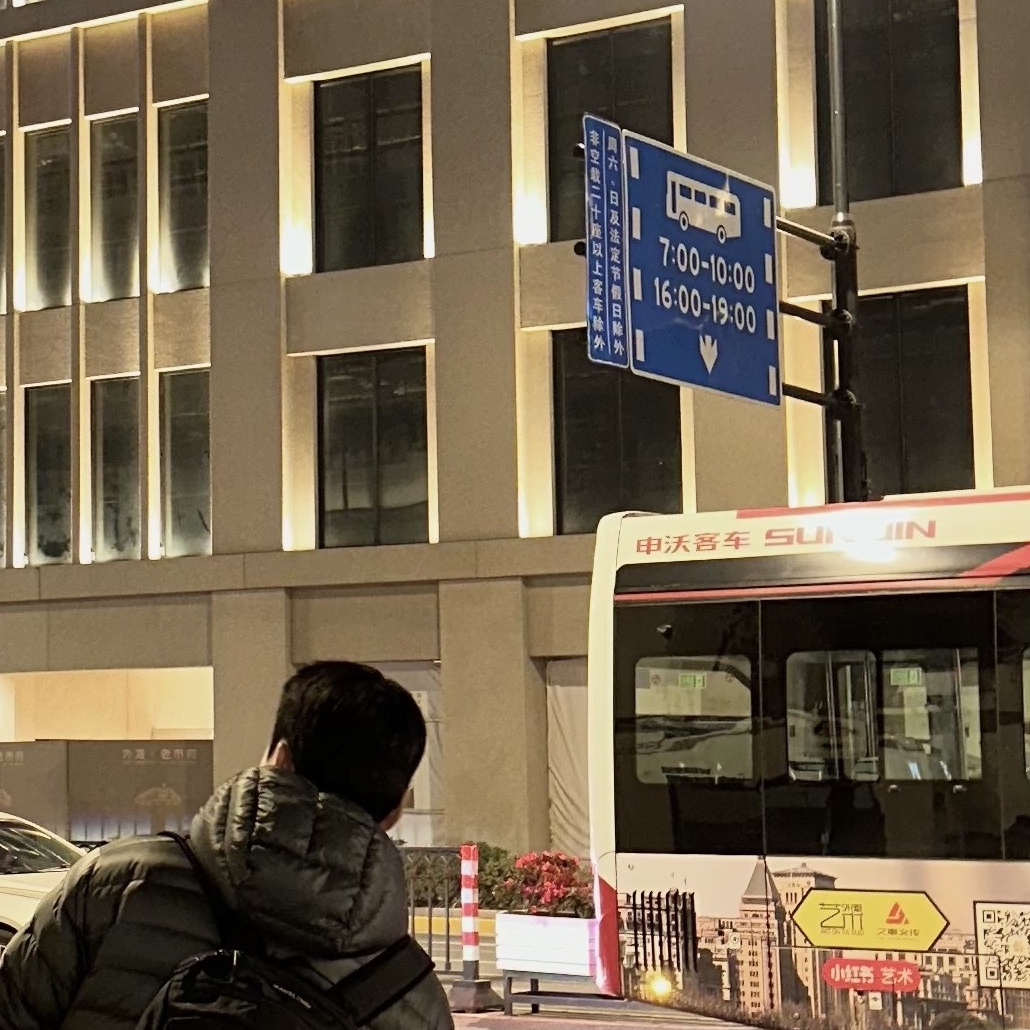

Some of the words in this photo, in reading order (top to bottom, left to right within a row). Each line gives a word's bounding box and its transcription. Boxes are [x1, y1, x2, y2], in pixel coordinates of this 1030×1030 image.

[658, 235, 756, 294] 7:00-10:00
[654, 276, 756, 334] 16:00-19:00
[635, 530, 750, 555] 申沃客车
[830, 963, 874, 984] 小红书
[880, 966, 914, 986] 艺术
